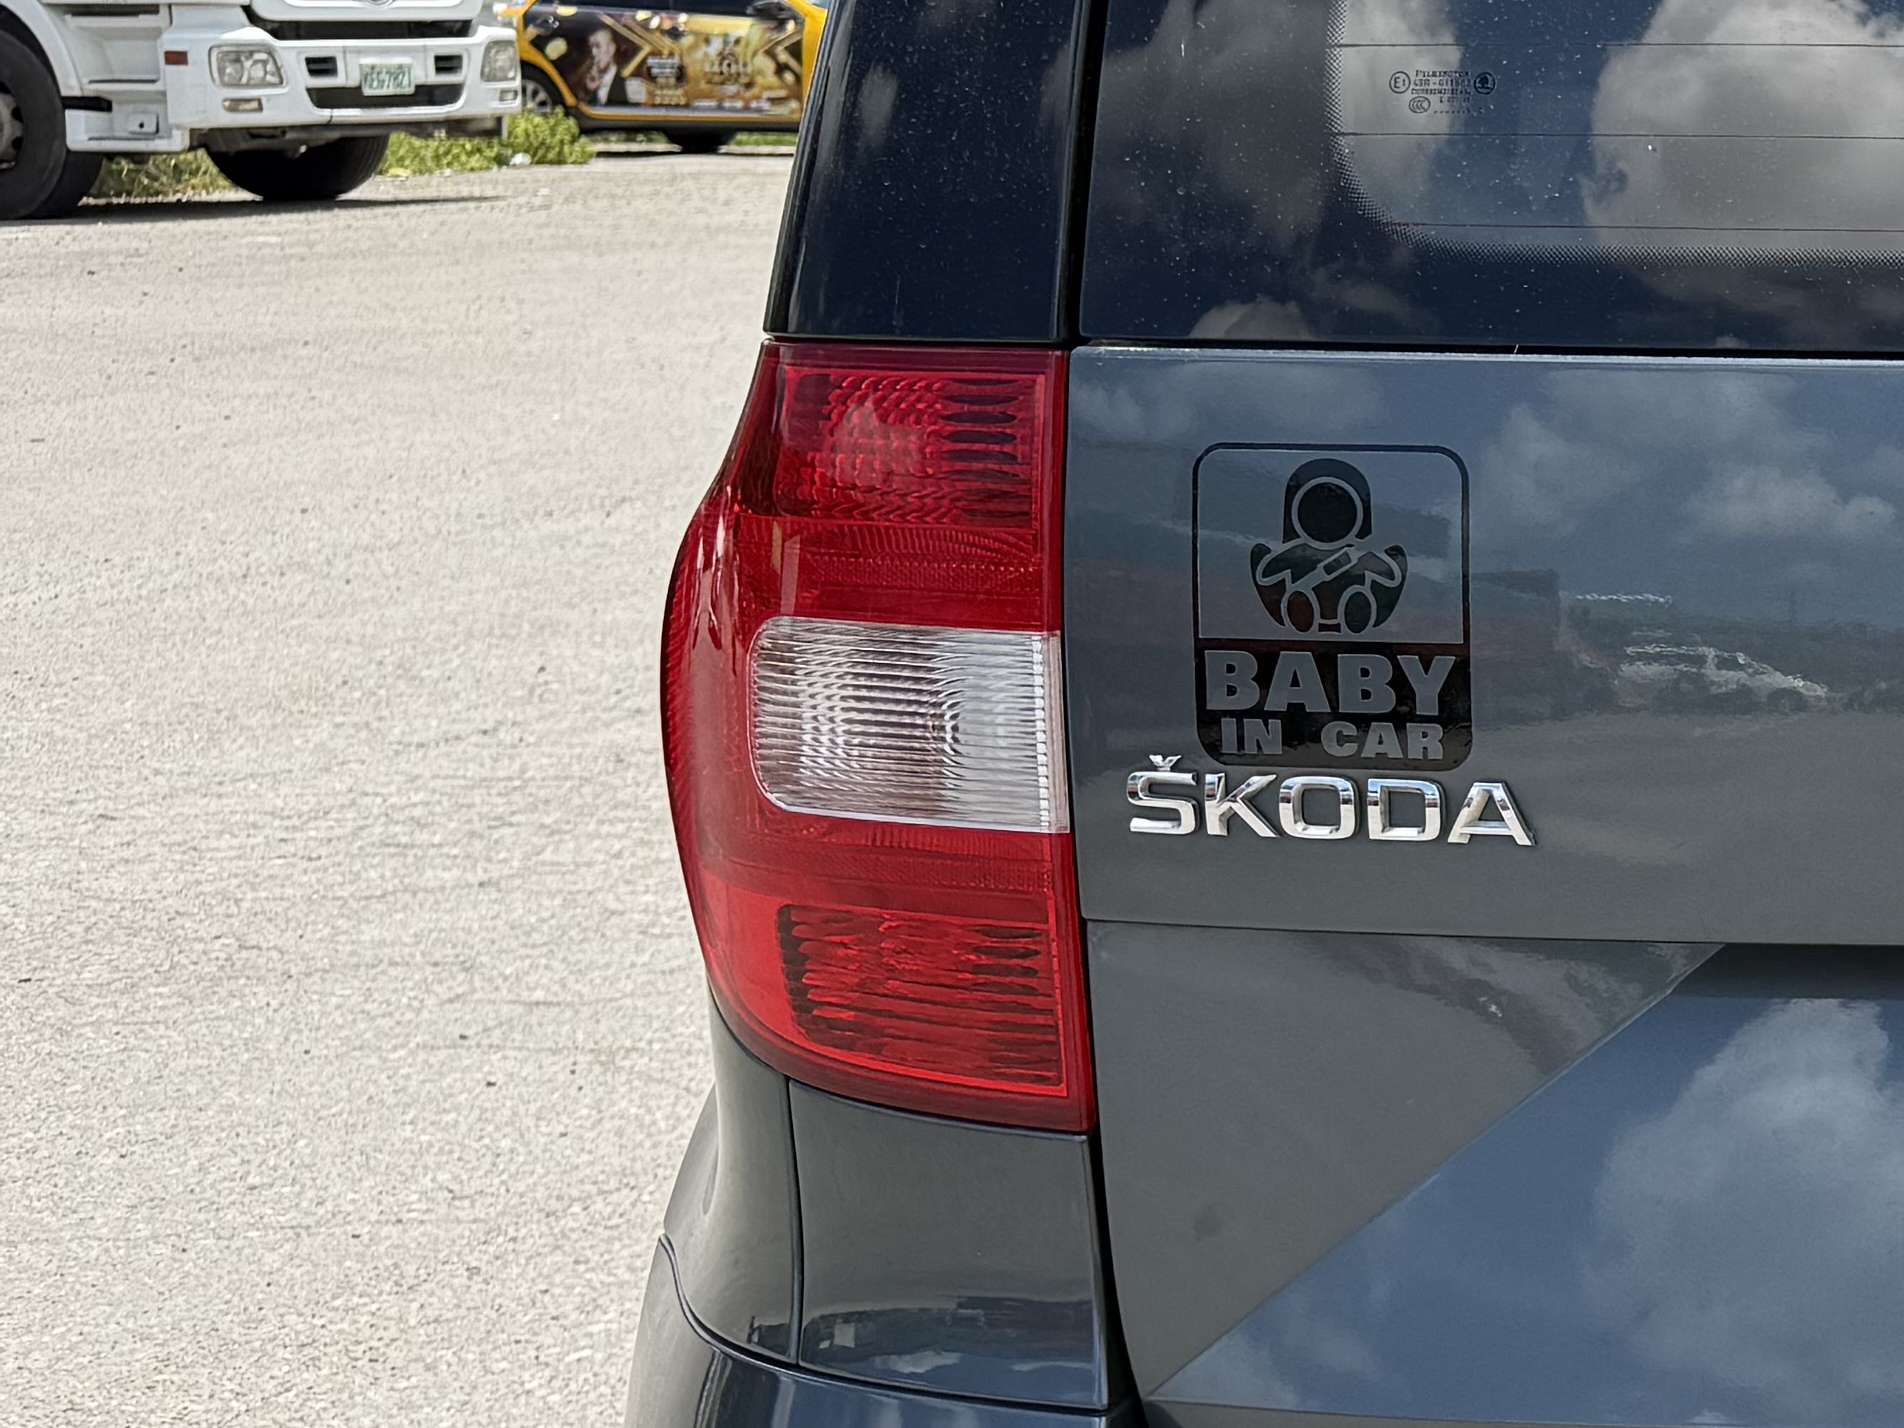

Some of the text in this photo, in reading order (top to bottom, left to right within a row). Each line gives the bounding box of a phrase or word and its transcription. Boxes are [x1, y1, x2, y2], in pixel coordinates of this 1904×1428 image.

[1204, 649, 1457, 716] BABY
[1220, 717, 1444, 761] IN CAR
[1125, 753, 1538, 847] ŠKODA
